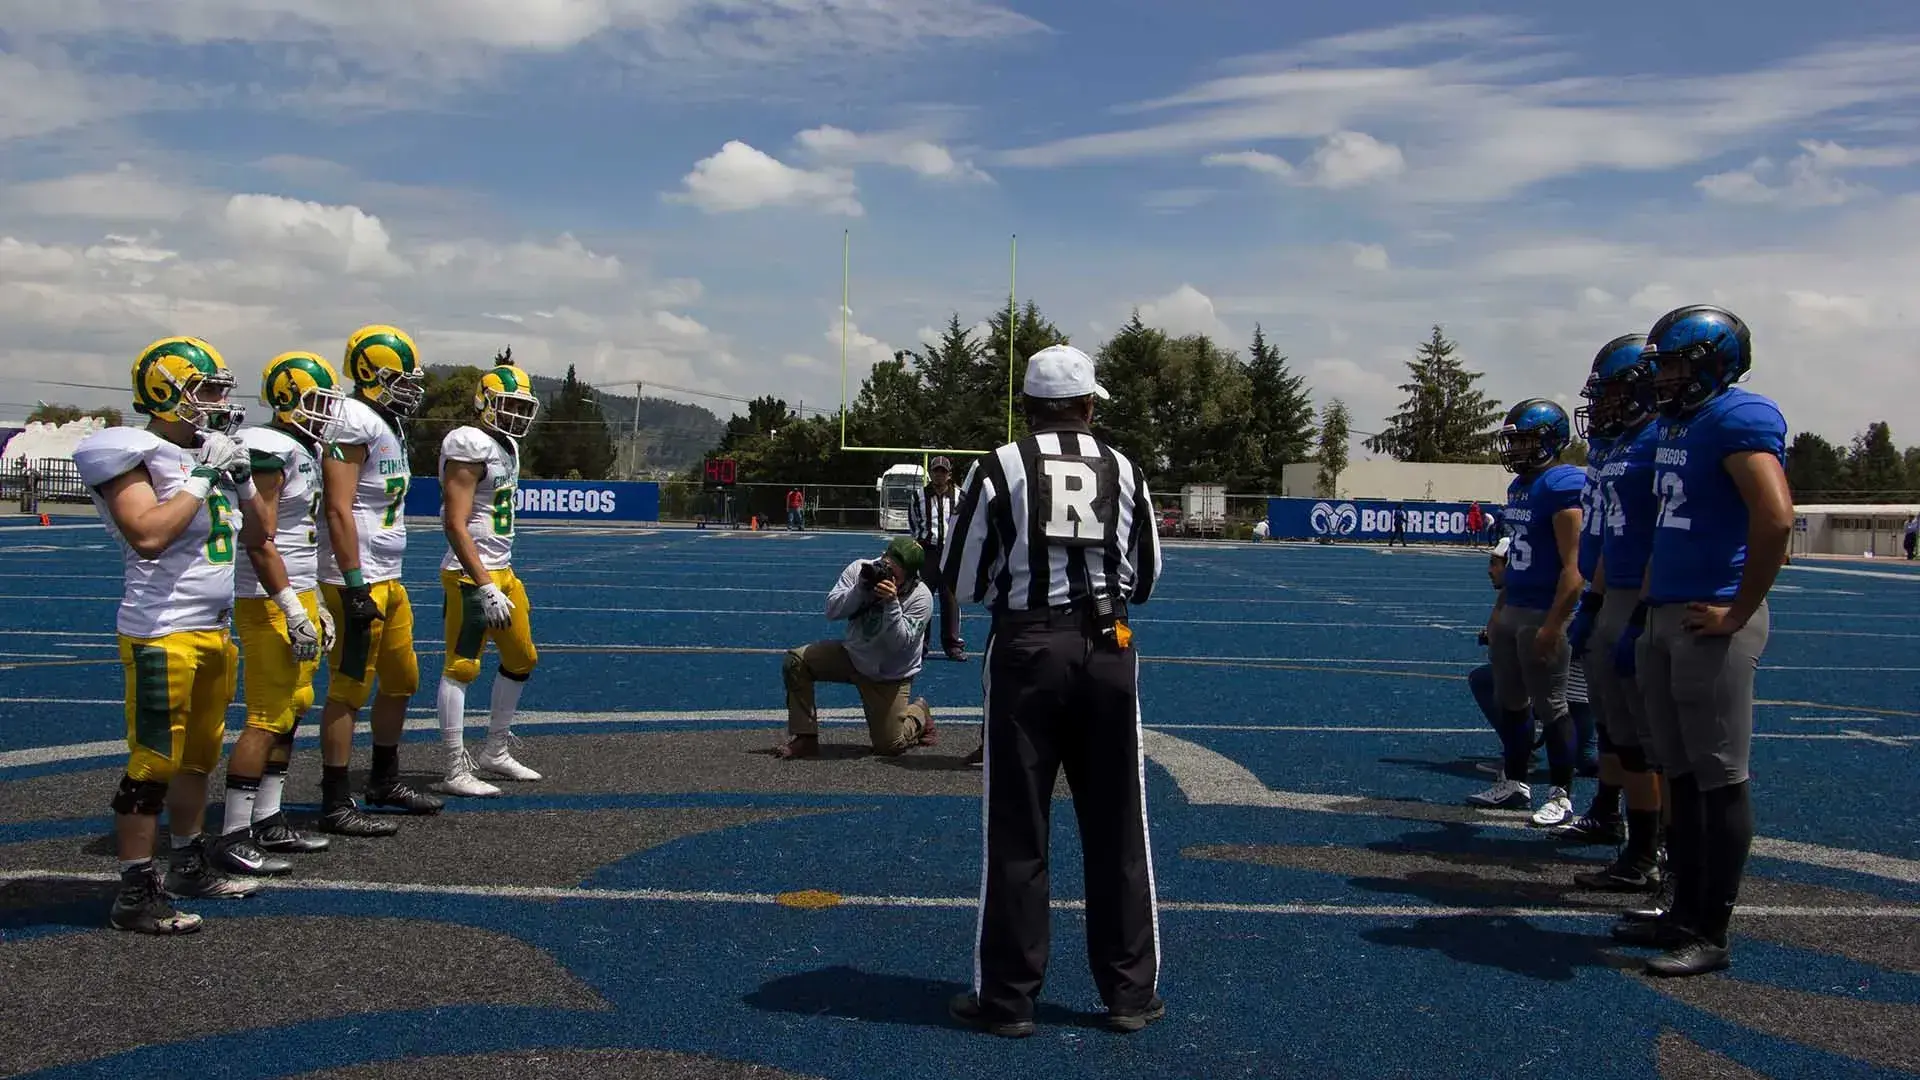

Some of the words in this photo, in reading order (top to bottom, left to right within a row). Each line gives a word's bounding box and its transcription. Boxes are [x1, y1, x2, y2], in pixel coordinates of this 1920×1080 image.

[384, 475, 405, 529] 7
[705, 459, 736, 483] 40
[1044, 459, 1104, 540] R
[206, 494, 233, 566] 6
